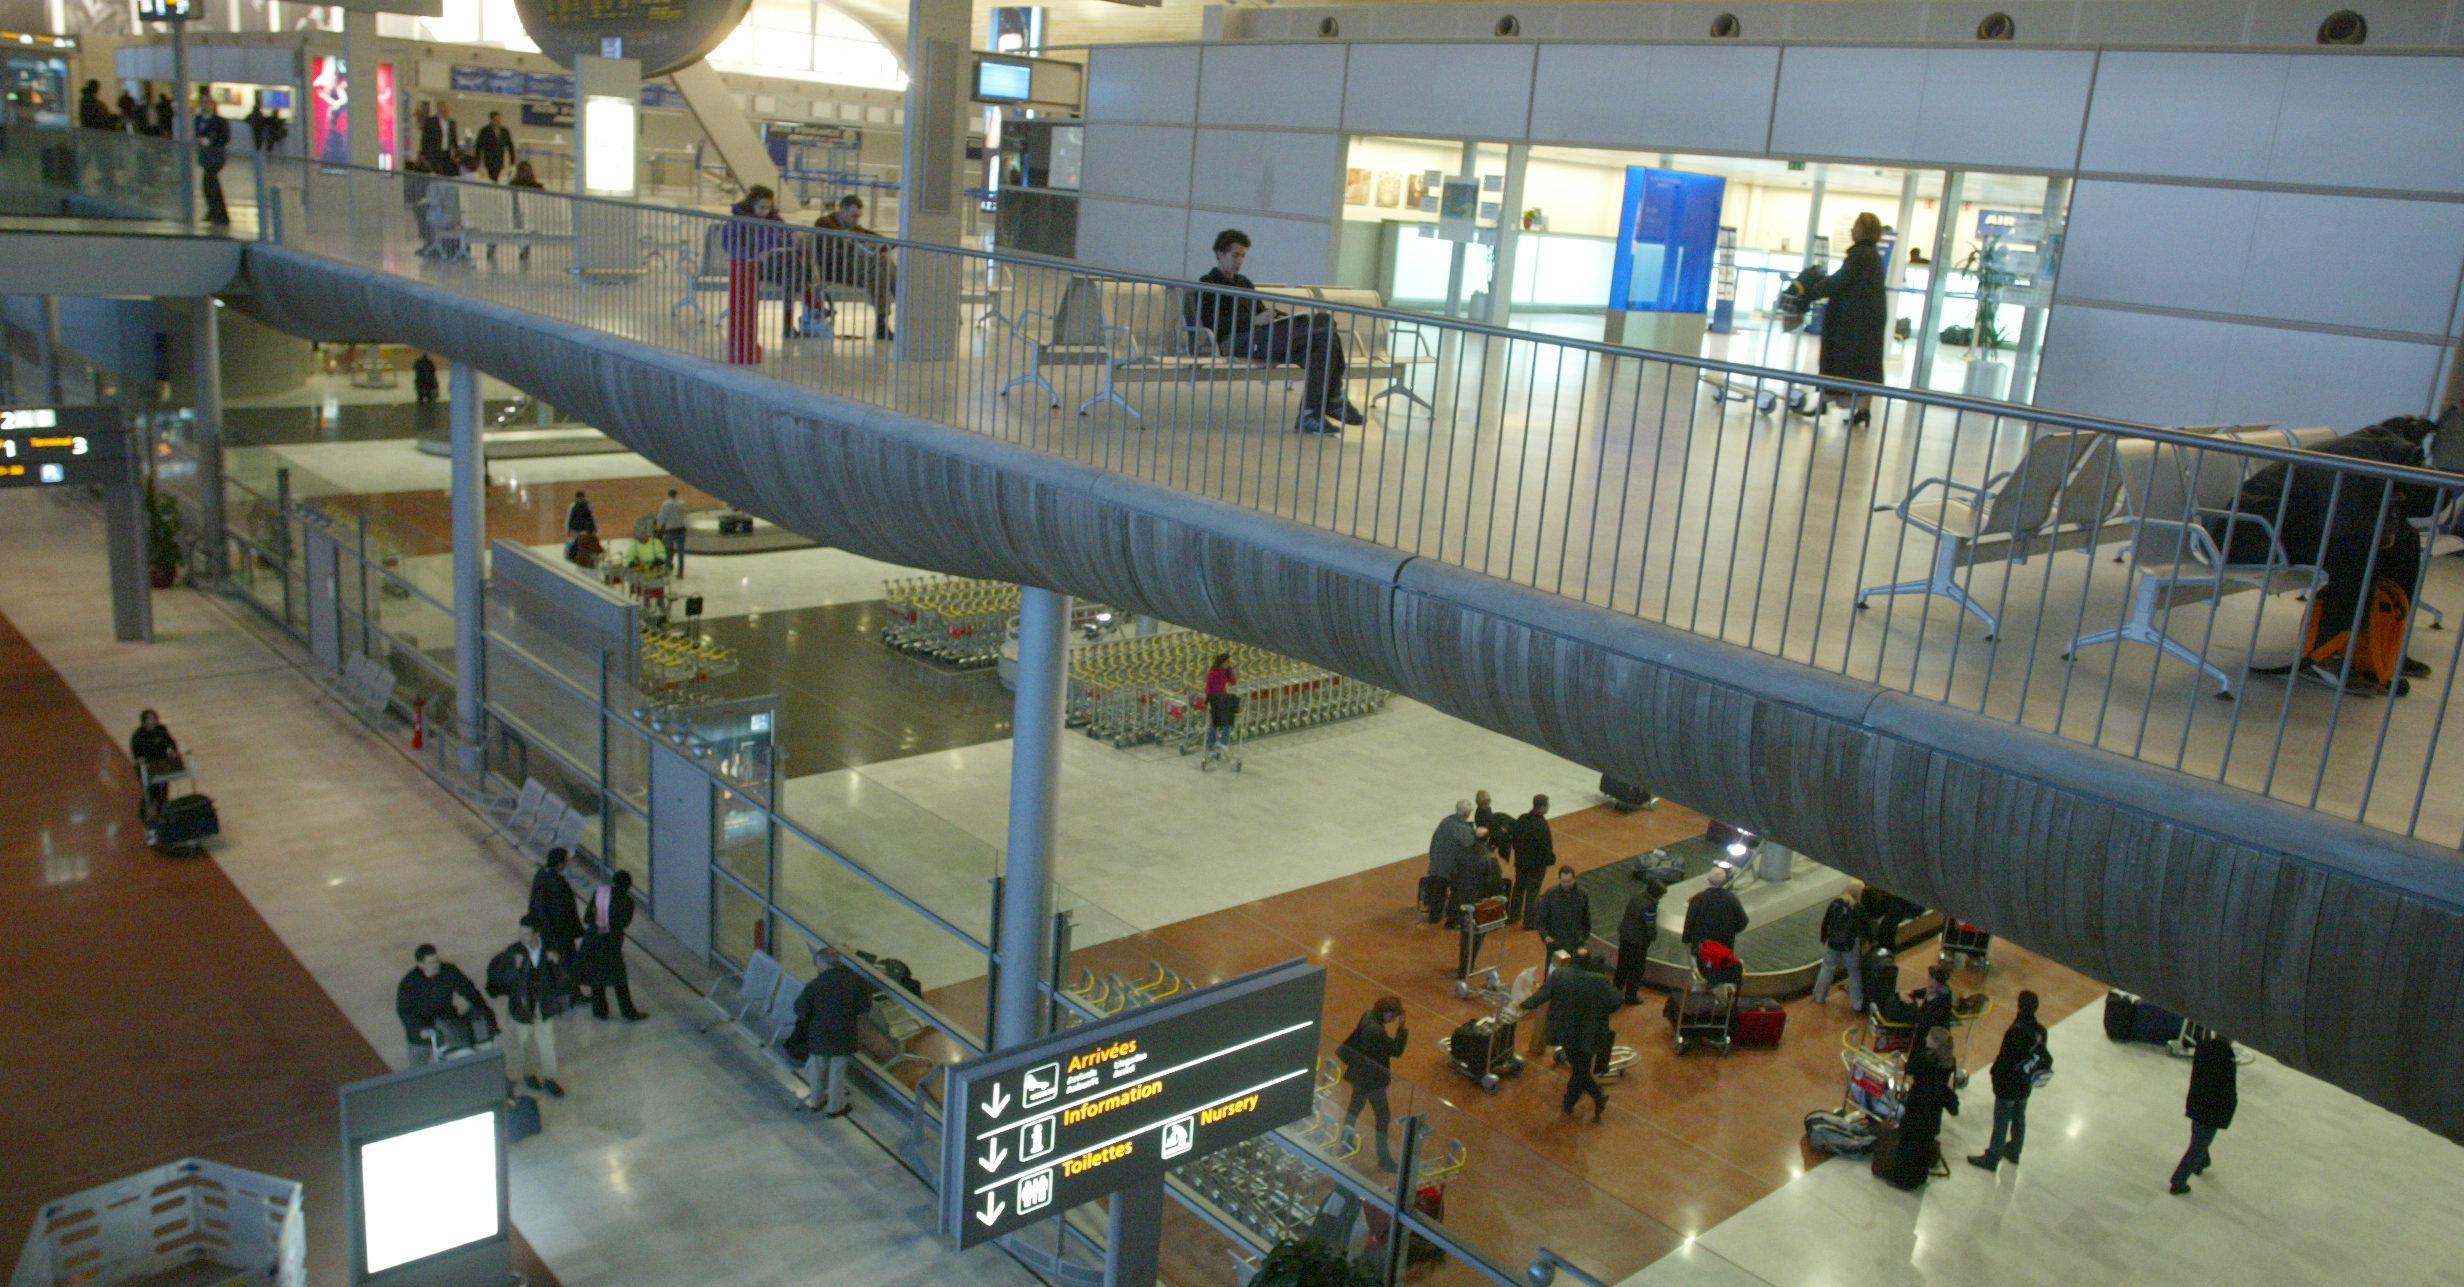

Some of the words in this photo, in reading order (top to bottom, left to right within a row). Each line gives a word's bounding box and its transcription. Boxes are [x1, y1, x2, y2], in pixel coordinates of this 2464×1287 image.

[72, 437, 88, 455] 3
[1067, 1040, 1137, 1073] Arrivées
[1063, 1081, 1163, 1126] Information
[1200, 1094, 1259, 1126] Nursery
[1061, 1141, 1133, 1177] Toilettes
